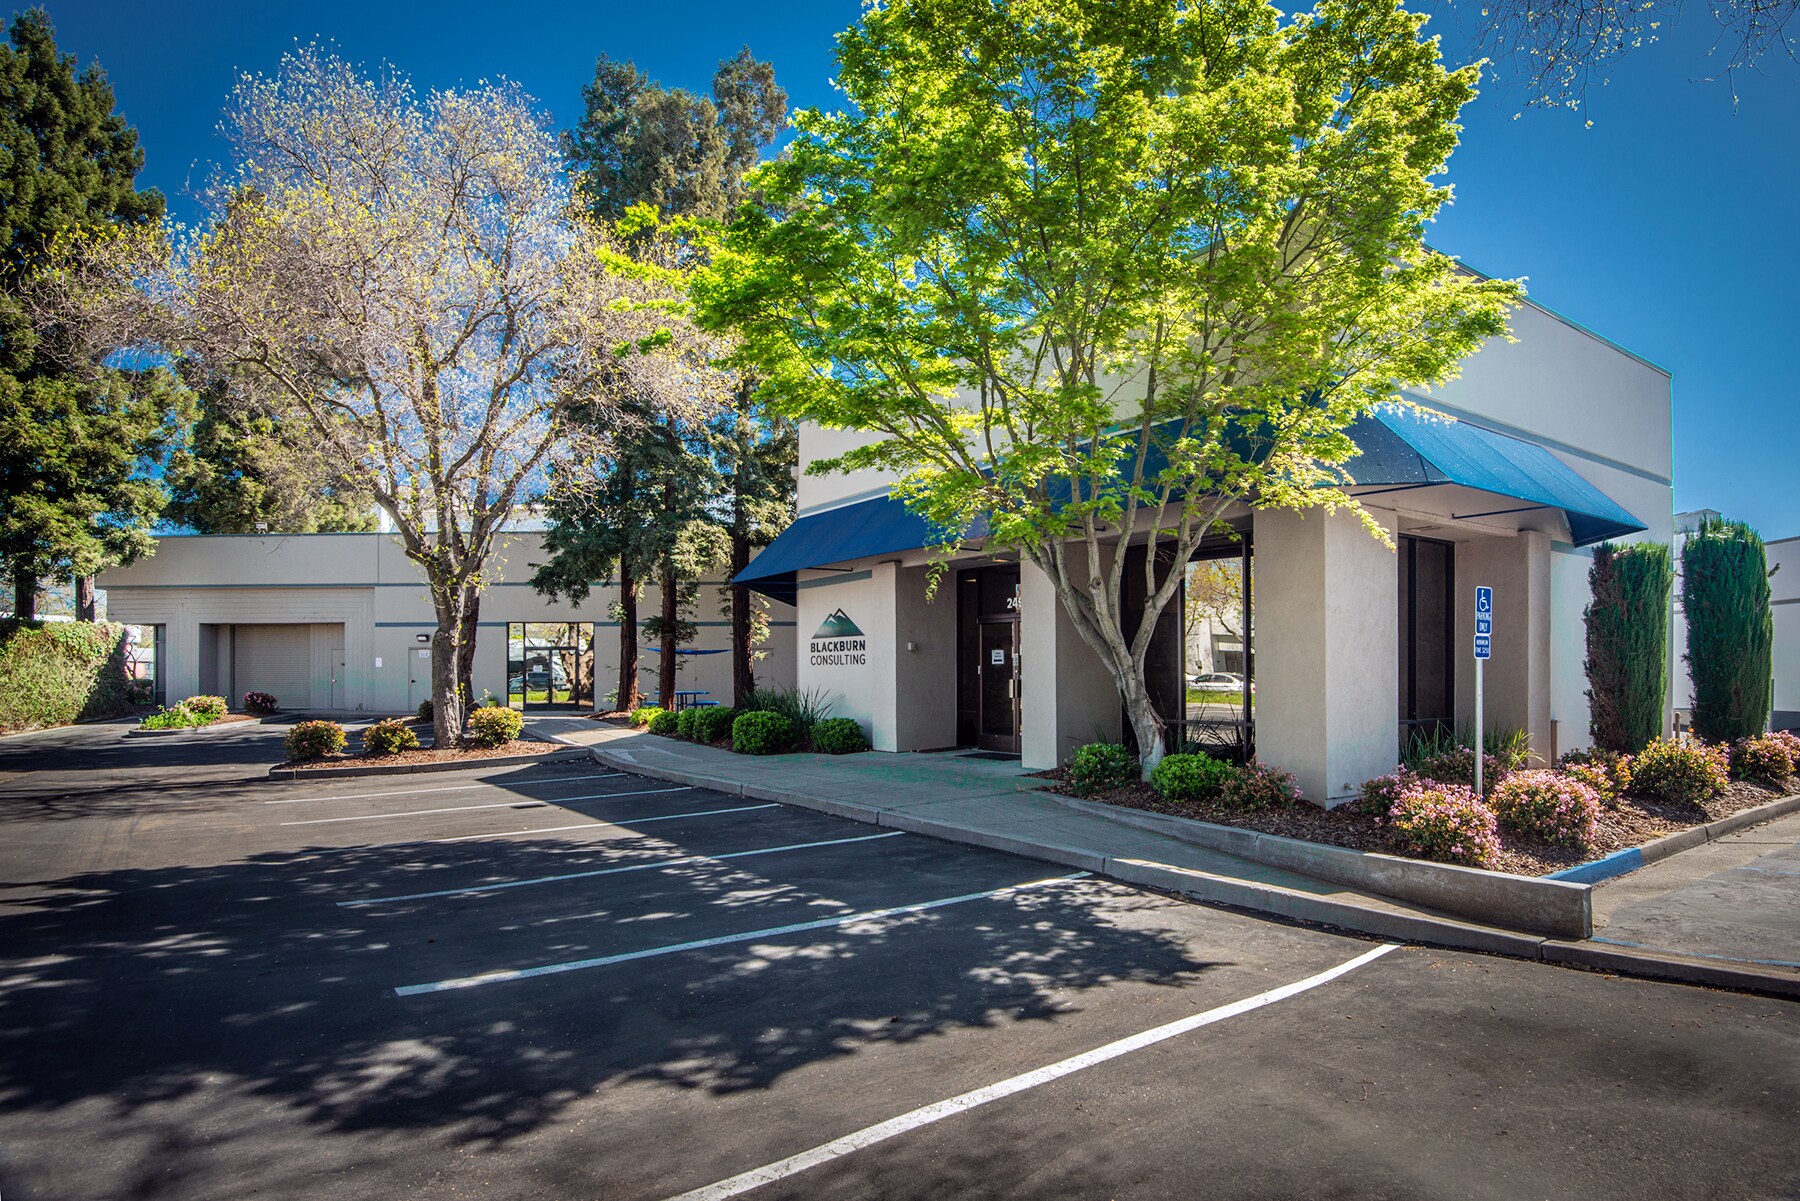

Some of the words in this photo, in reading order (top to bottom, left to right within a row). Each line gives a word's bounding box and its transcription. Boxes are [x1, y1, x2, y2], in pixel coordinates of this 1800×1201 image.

[1476, 612, 1491, 620] PARKING
[1479, 622, 1488, 632] ONLY
[810, 639, 866, 653] BLACKBURN
[810, 653, 866, 666] CONSULTING
